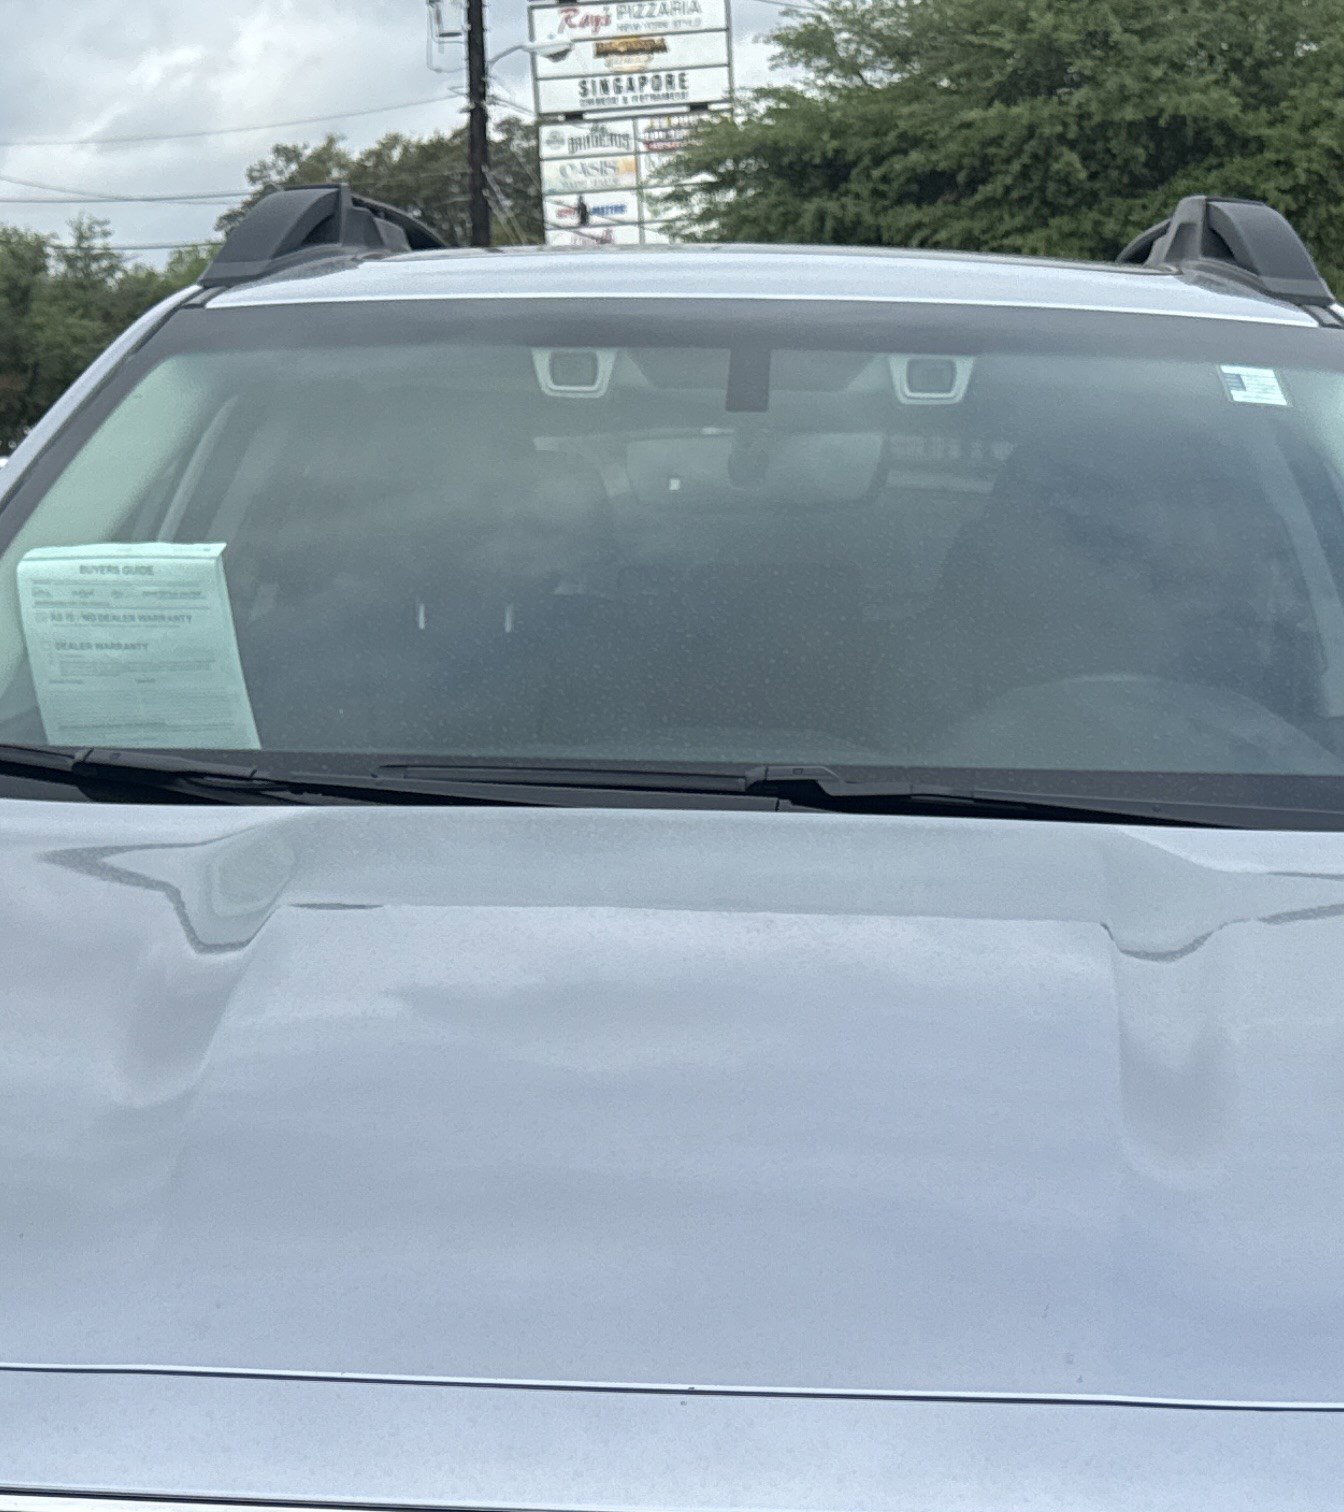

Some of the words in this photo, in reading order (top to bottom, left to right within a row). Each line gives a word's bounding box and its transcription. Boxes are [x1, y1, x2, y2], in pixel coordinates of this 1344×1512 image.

[578, 72, 690, 98] SINGAPORE
[122, 565, 154, 576] GUIDE
[137, 613, 192, 623] WARRANTY
[95, 641, 149, 650] WARRANTY
